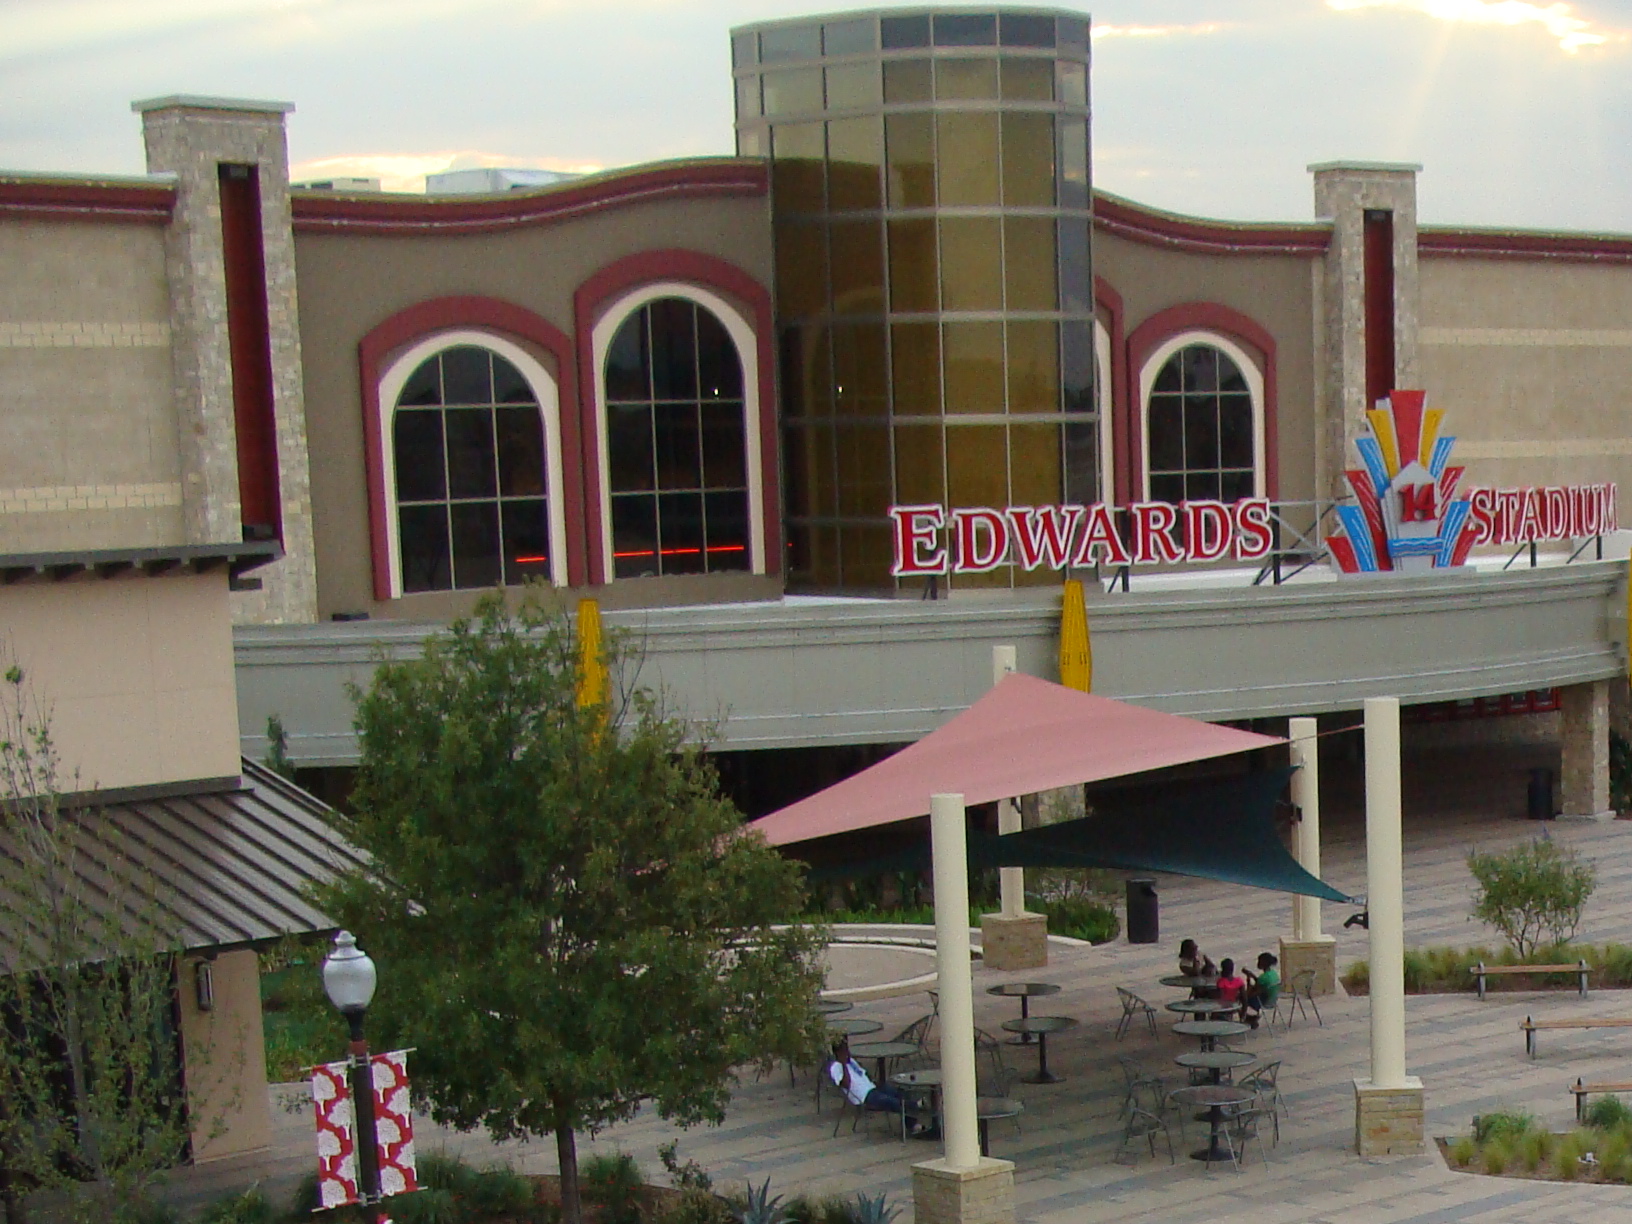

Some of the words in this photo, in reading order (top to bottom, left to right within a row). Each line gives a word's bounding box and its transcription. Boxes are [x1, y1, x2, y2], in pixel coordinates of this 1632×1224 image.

[889, 498, 1274, 577] EDWARDS
[1399, 482, 1437, 522] 14
[1468, 483, 1619, 547] STADIUM
